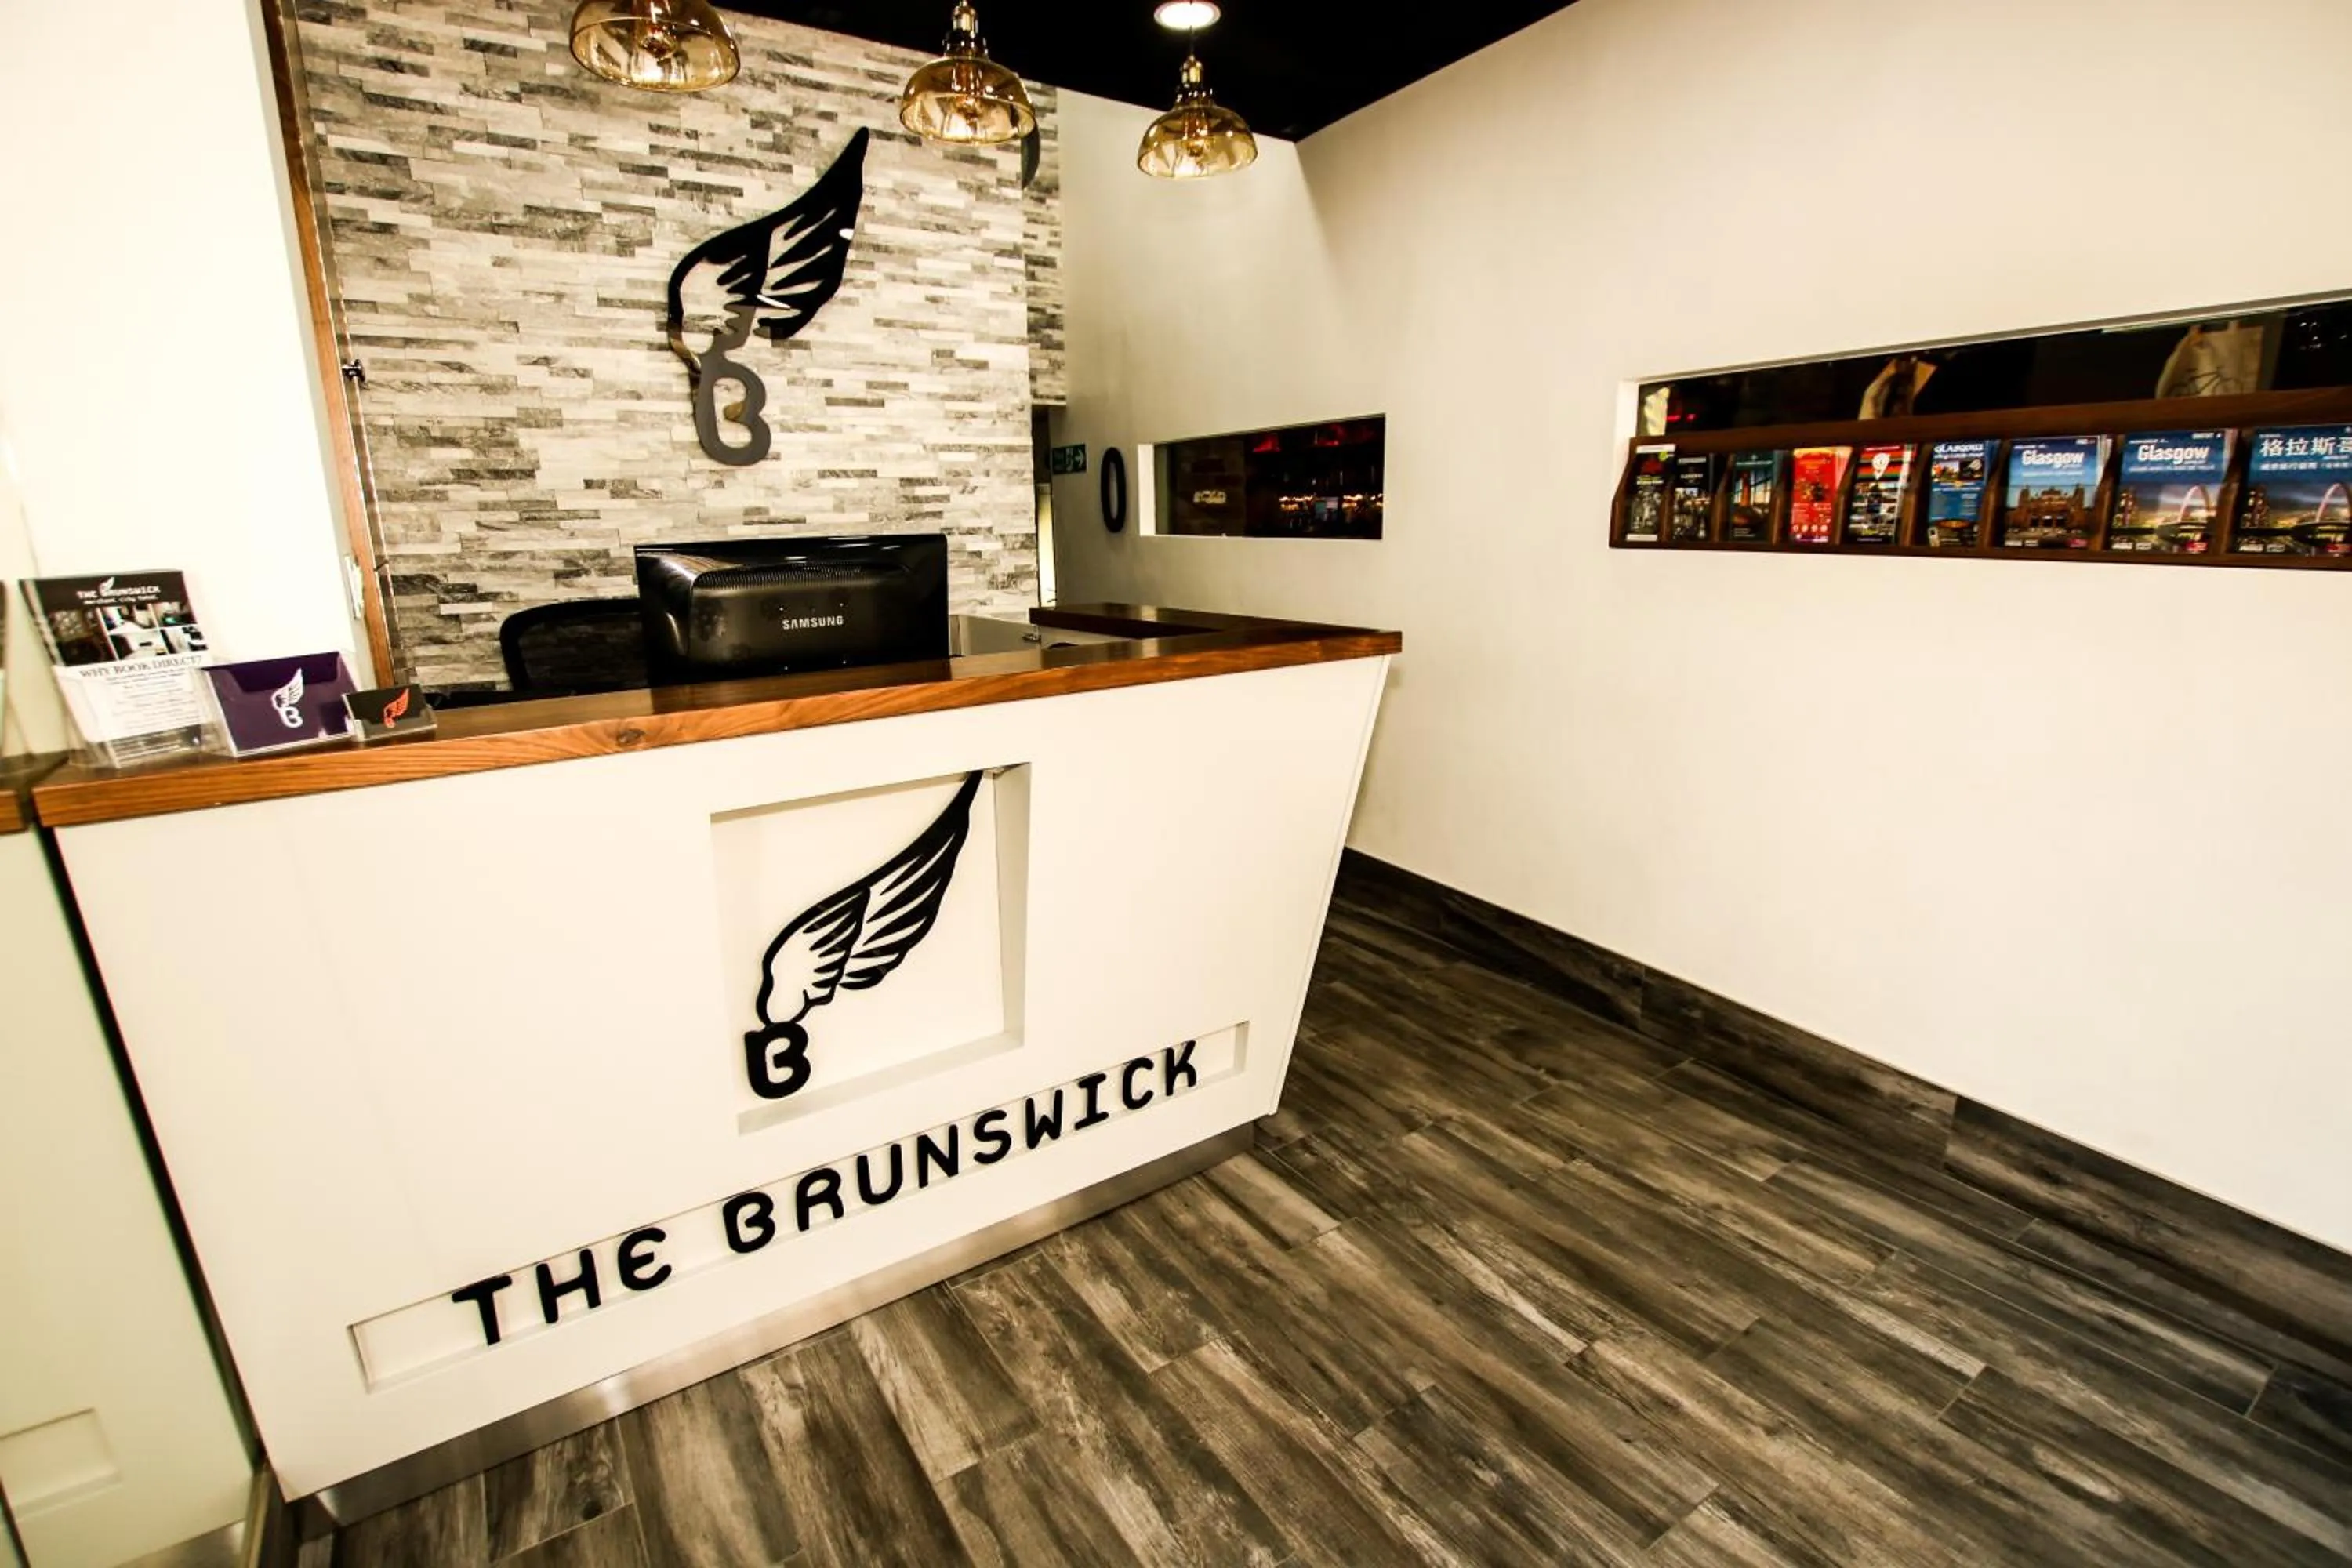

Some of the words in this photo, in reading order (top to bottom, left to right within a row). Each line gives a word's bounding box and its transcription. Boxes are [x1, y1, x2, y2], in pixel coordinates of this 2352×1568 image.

[2022, 449, 2085, 468] Glasgow
[2137, 444, 2209, 464] Glasgow
[76, 590, 98, 599] THE
[782, 615, 844, 630] SAMSUNG
[79, 666, 111, 677] WHY
[113, 662, 151, 675] BOOK
[152, 655, 202, 669] DIRECT?
[452, 1227, 672, 1345] THE
[722, 1040, 1196, 1254] BRUNSWICK
